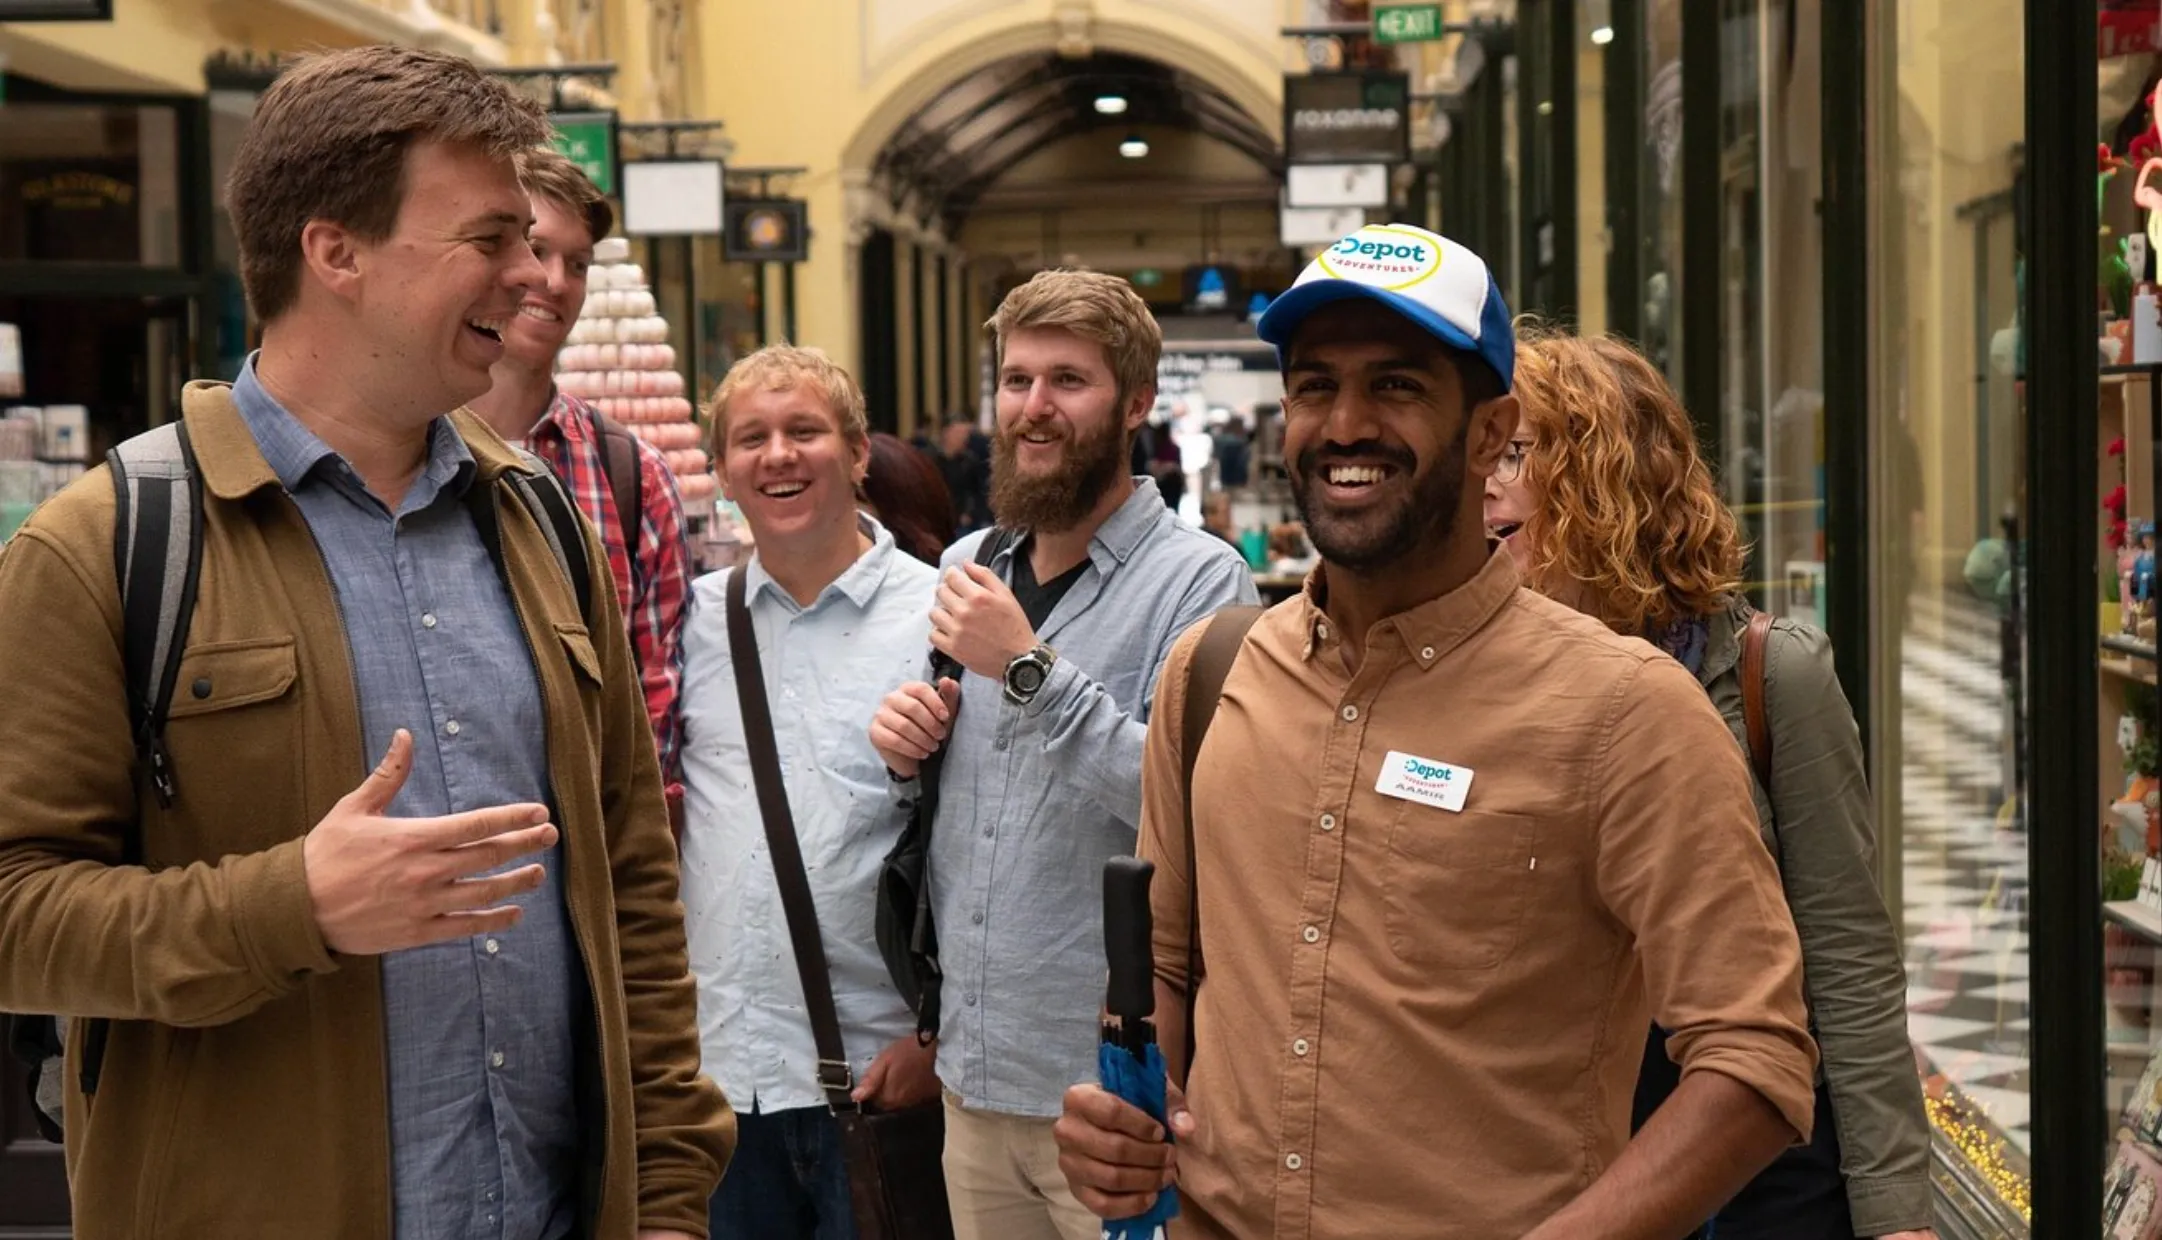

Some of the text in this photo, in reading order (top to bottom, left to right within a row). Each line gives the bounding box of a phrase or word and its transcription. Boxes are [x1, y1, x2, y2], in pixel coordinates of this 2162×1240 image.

[1390, 9, 1435, 36] EXIT
[1294, 108, 1400, 131] roxanne
[1333, 237, 1426, 263] Depot
[1403, 759, 1452, 780] Depot
